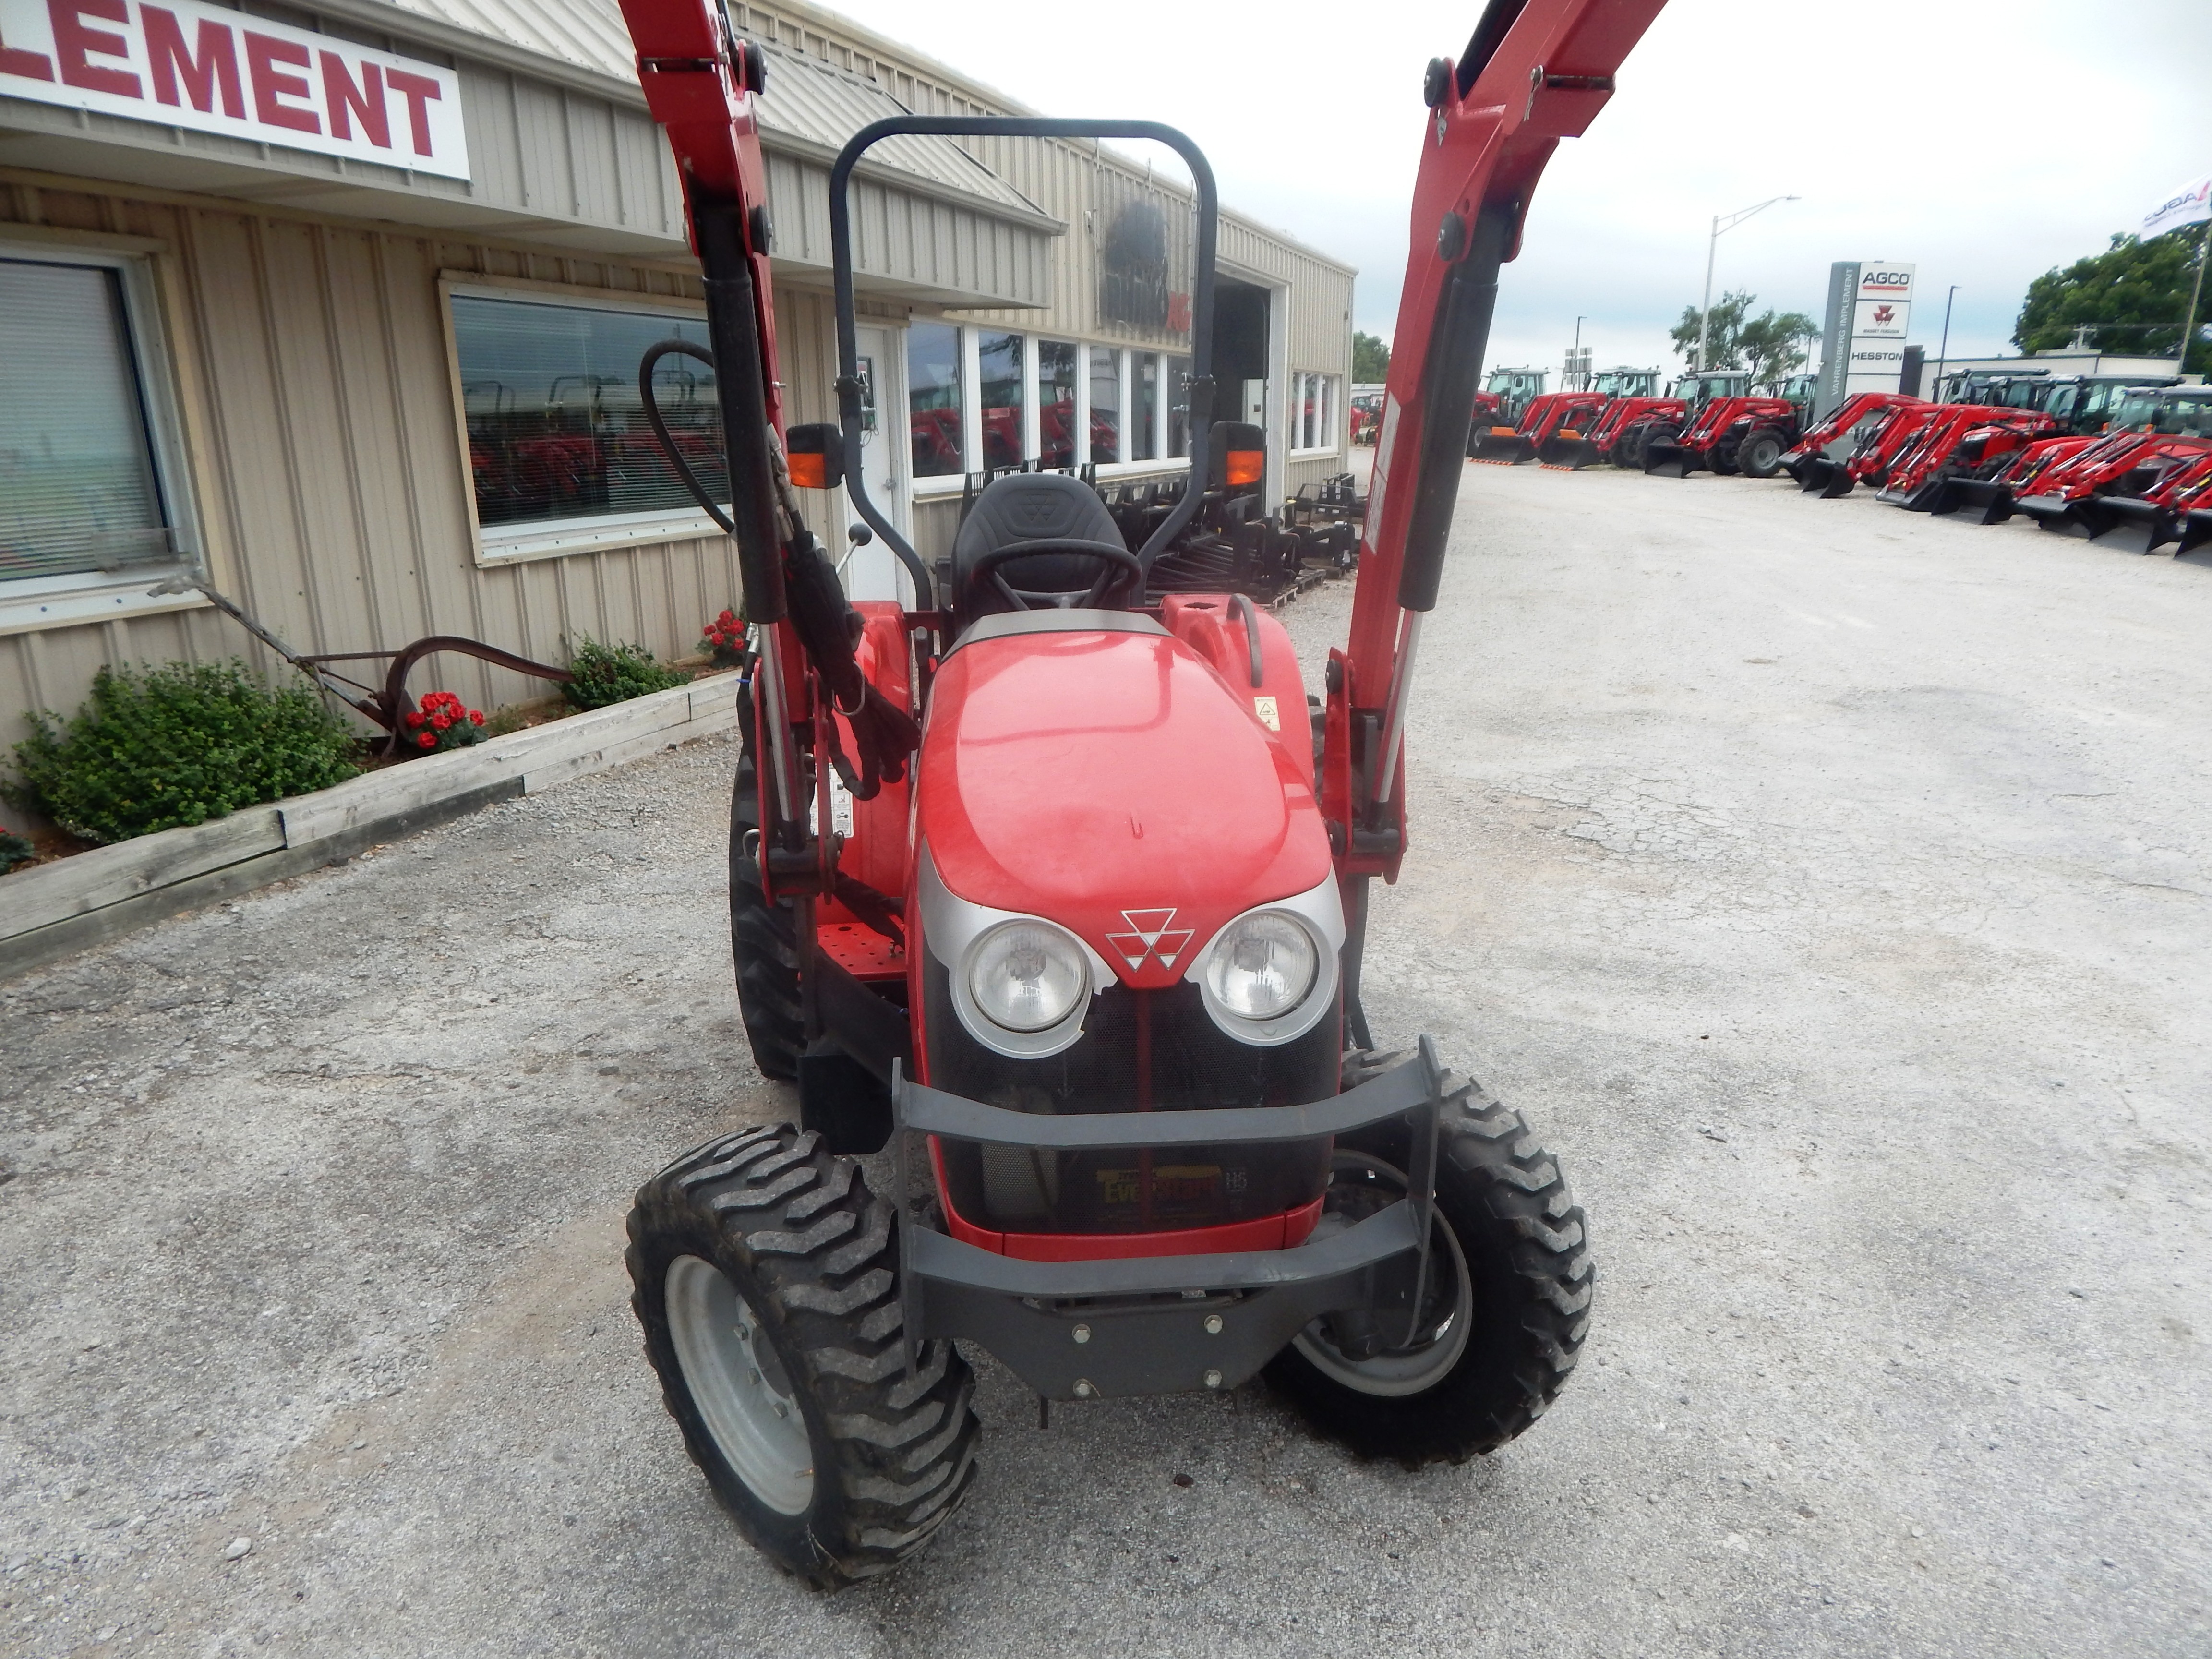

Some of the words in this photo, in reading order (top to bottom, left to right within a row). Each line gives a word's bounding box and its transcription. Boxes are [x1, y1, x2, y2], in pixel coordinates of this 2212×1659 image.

[1862, 272, 1910, 285] AGCO
[1831, 329, 1846, 396] VAHRENBERG
[1839, 267, 1853, 327] IMPLEMENT
[1851, 352, 1903, 361] HESSTON
